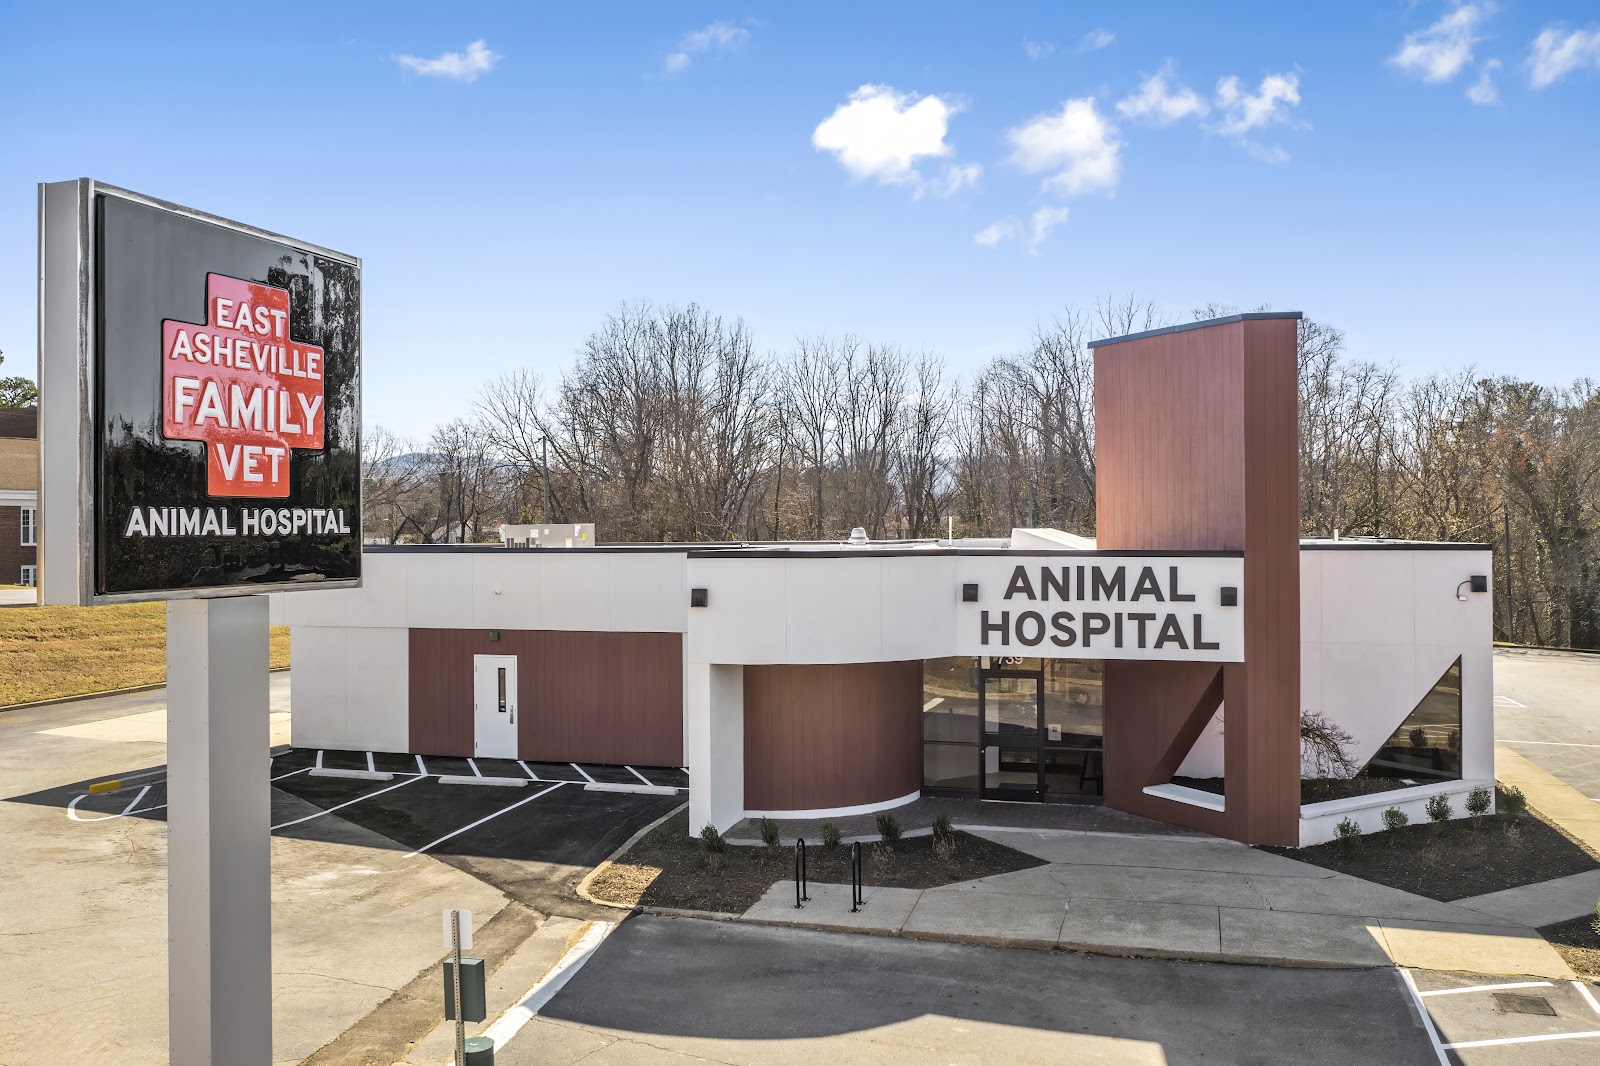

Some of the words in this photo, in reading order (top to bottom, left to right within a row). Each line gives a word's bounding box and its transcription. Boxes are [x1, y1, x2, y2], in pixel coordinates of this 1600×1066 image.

[216, 297, 287, 338] EAST
[171, 329, 321, 380] ASHEVILLE
[174, 376, 324, 436] FAMILY
[216, 443, 285, 483] VET
[125, 506, 237, 537] ANIMAL
[241, 507, 351, 535] HOSPITAL
[1003, 565, 1196, 602] ANIMAL
[980, 610, 1220, 650] HOSPITAL
